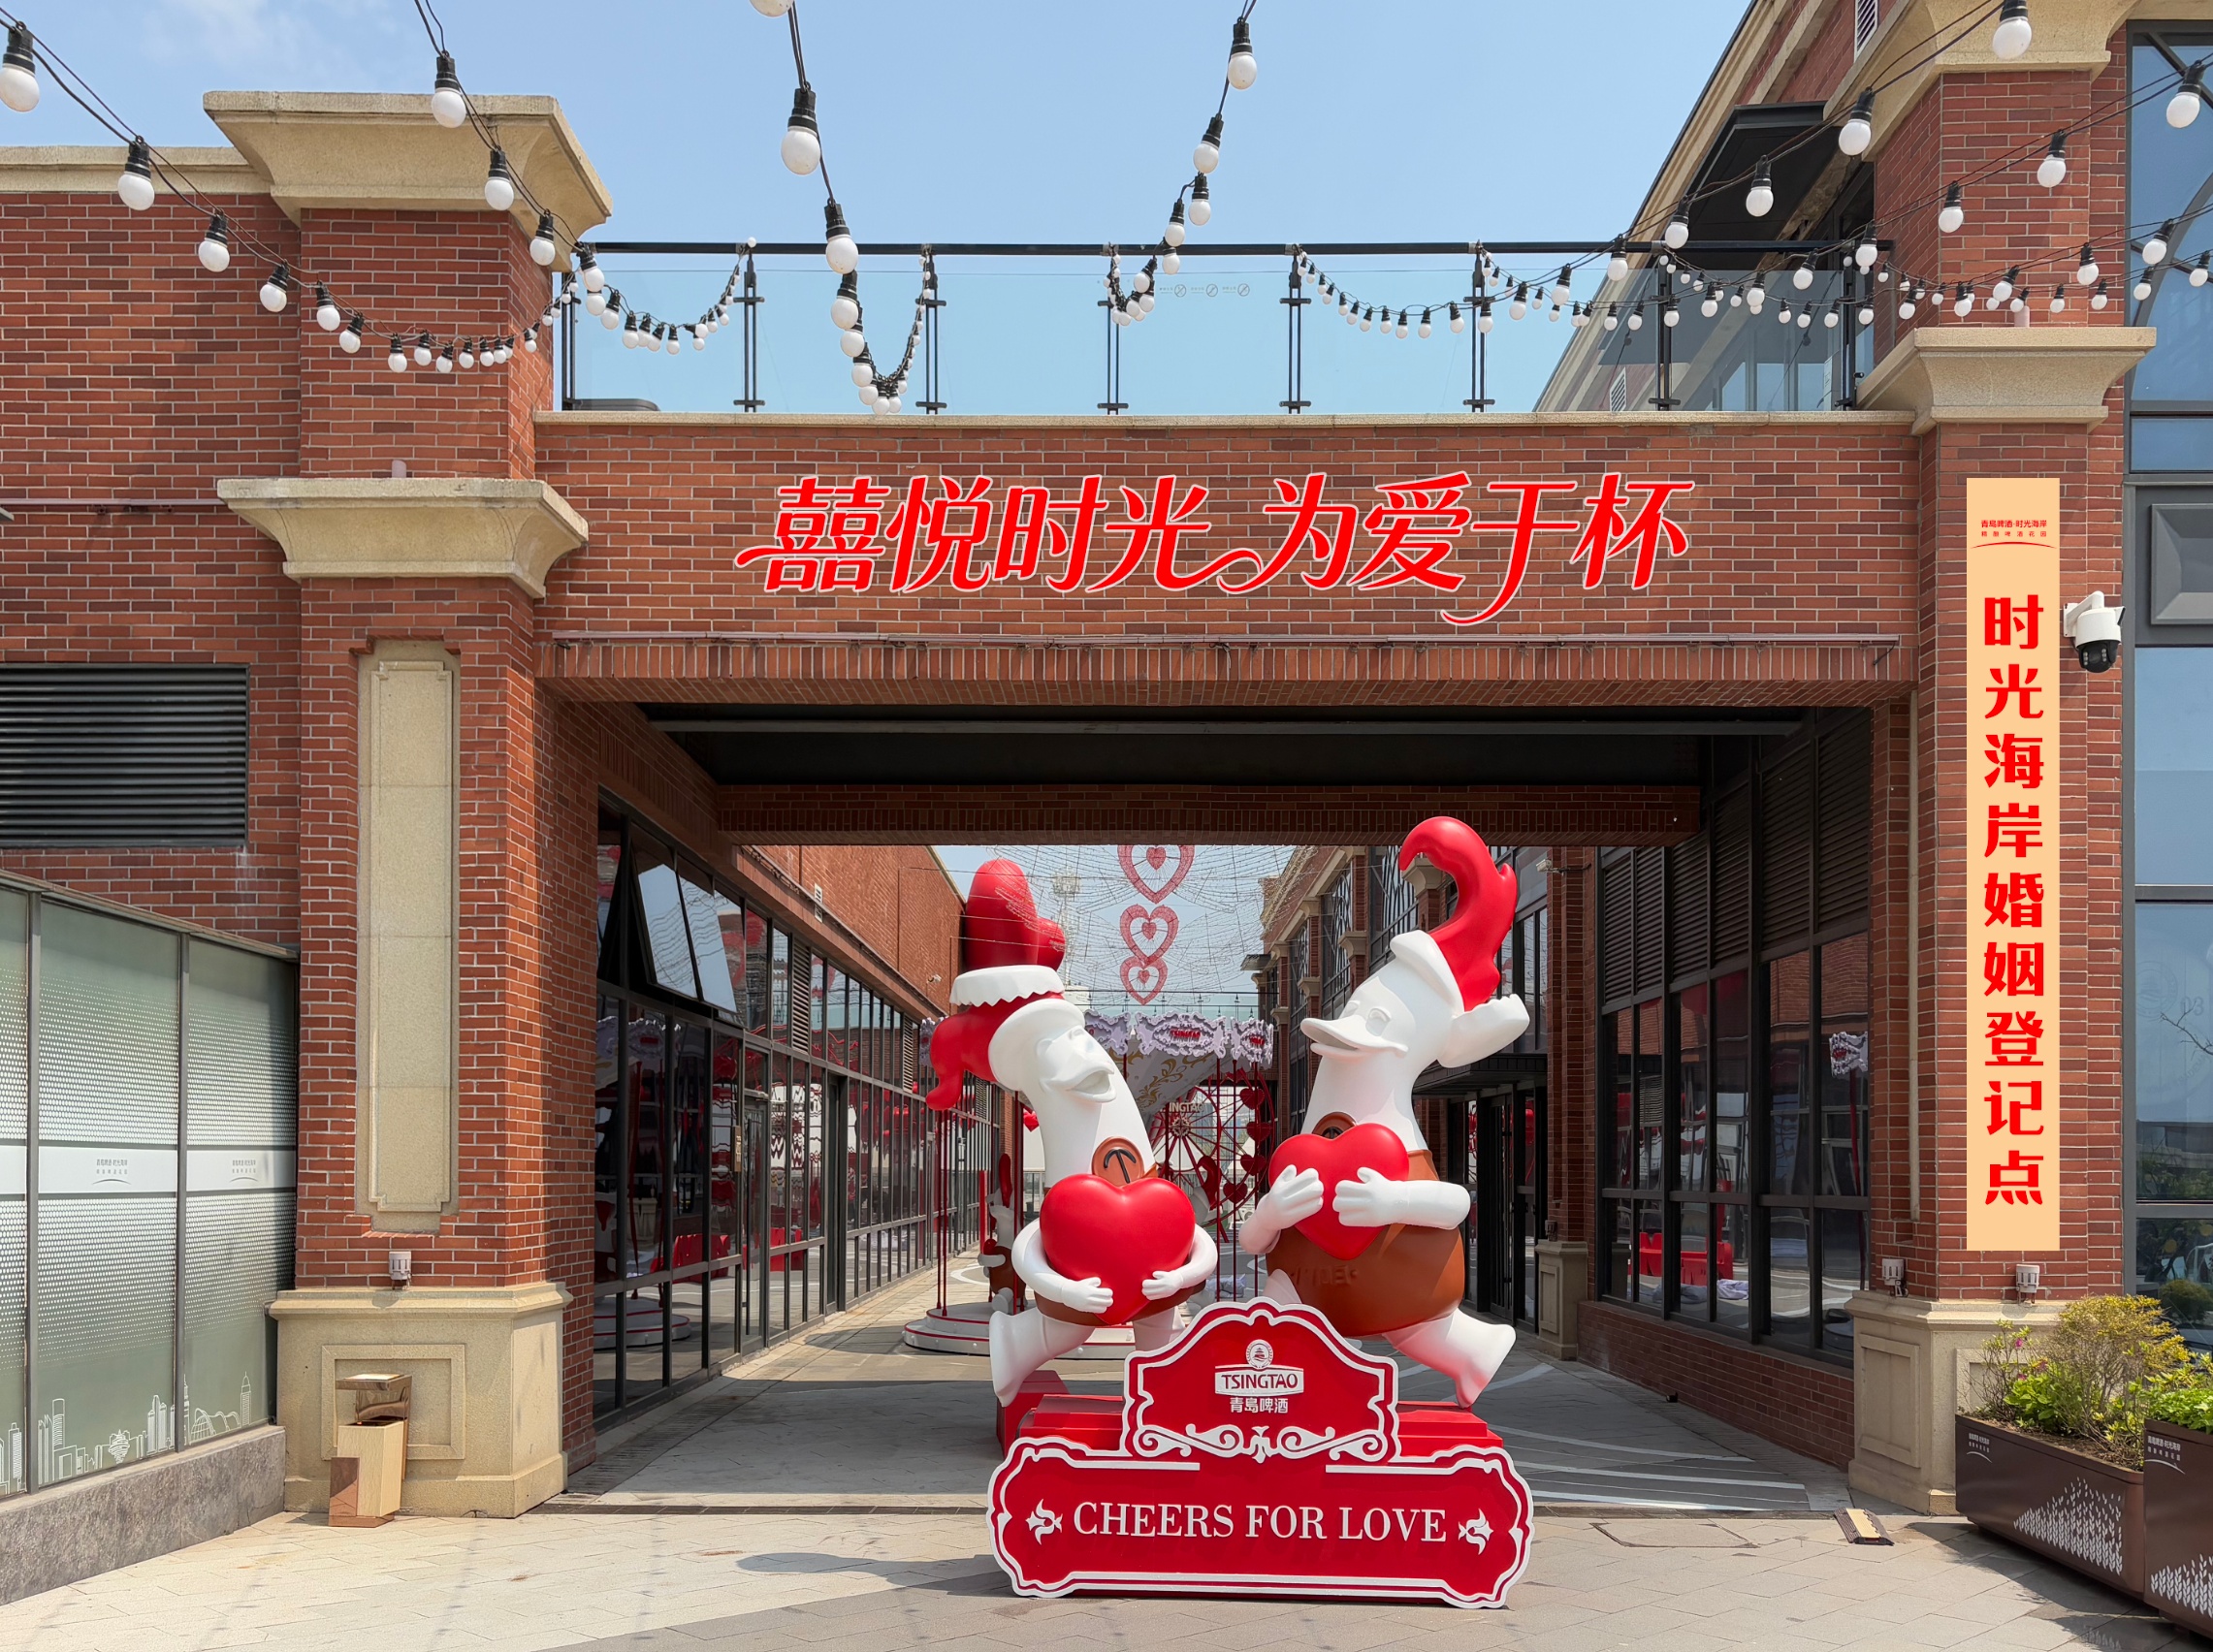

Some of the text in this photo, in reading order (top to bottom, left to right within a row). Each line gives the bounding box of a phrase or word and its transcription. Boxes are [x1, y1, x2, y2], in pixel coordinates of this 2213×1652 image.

[1984, 594, 2045, 1205] 时光海岸婚姻登记点
[1221, 1373, 1299, 1389] TSINGTAO
[1074, 1502, 1447, 1542] CHEERS FOR LOVE
